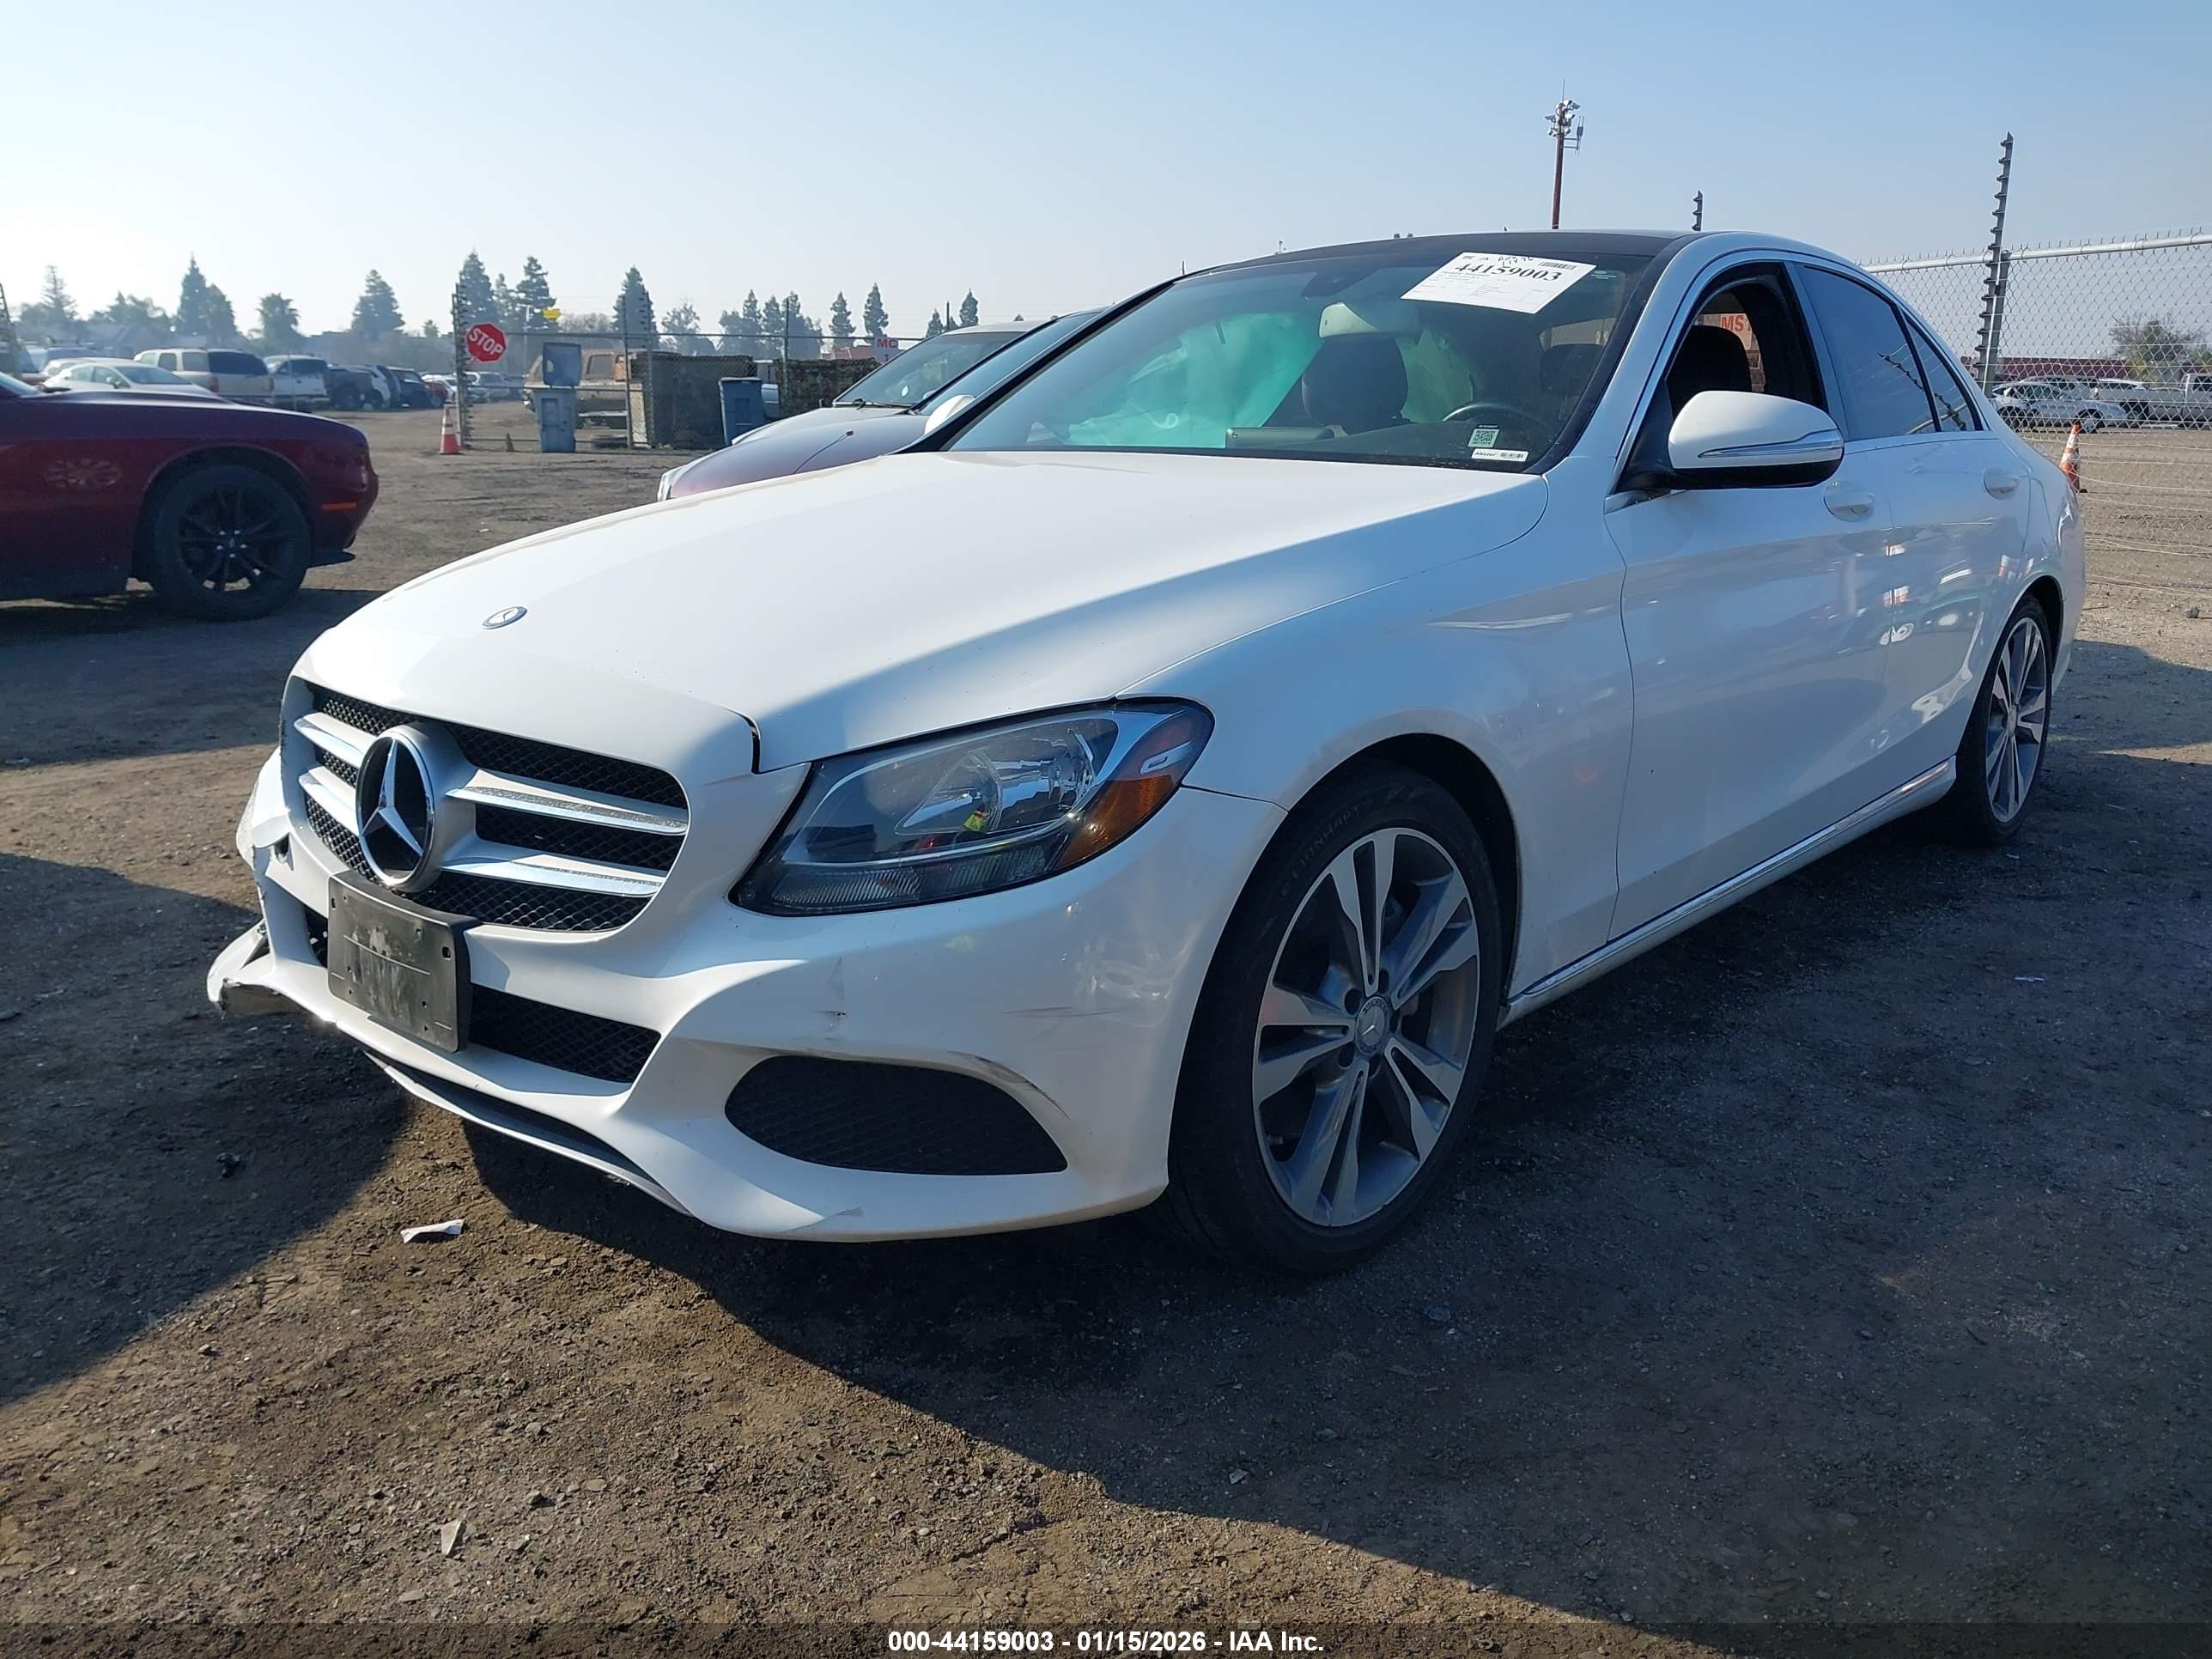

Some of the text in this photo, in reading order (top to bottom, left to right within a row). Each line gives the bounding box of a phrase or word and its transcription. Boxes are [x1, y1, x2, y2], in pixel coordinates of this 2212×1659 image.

[1455, 263, 1563, 282] 44159003
[468, 327, 504, 356] STOP
[877, 338, 896, 349] MC
